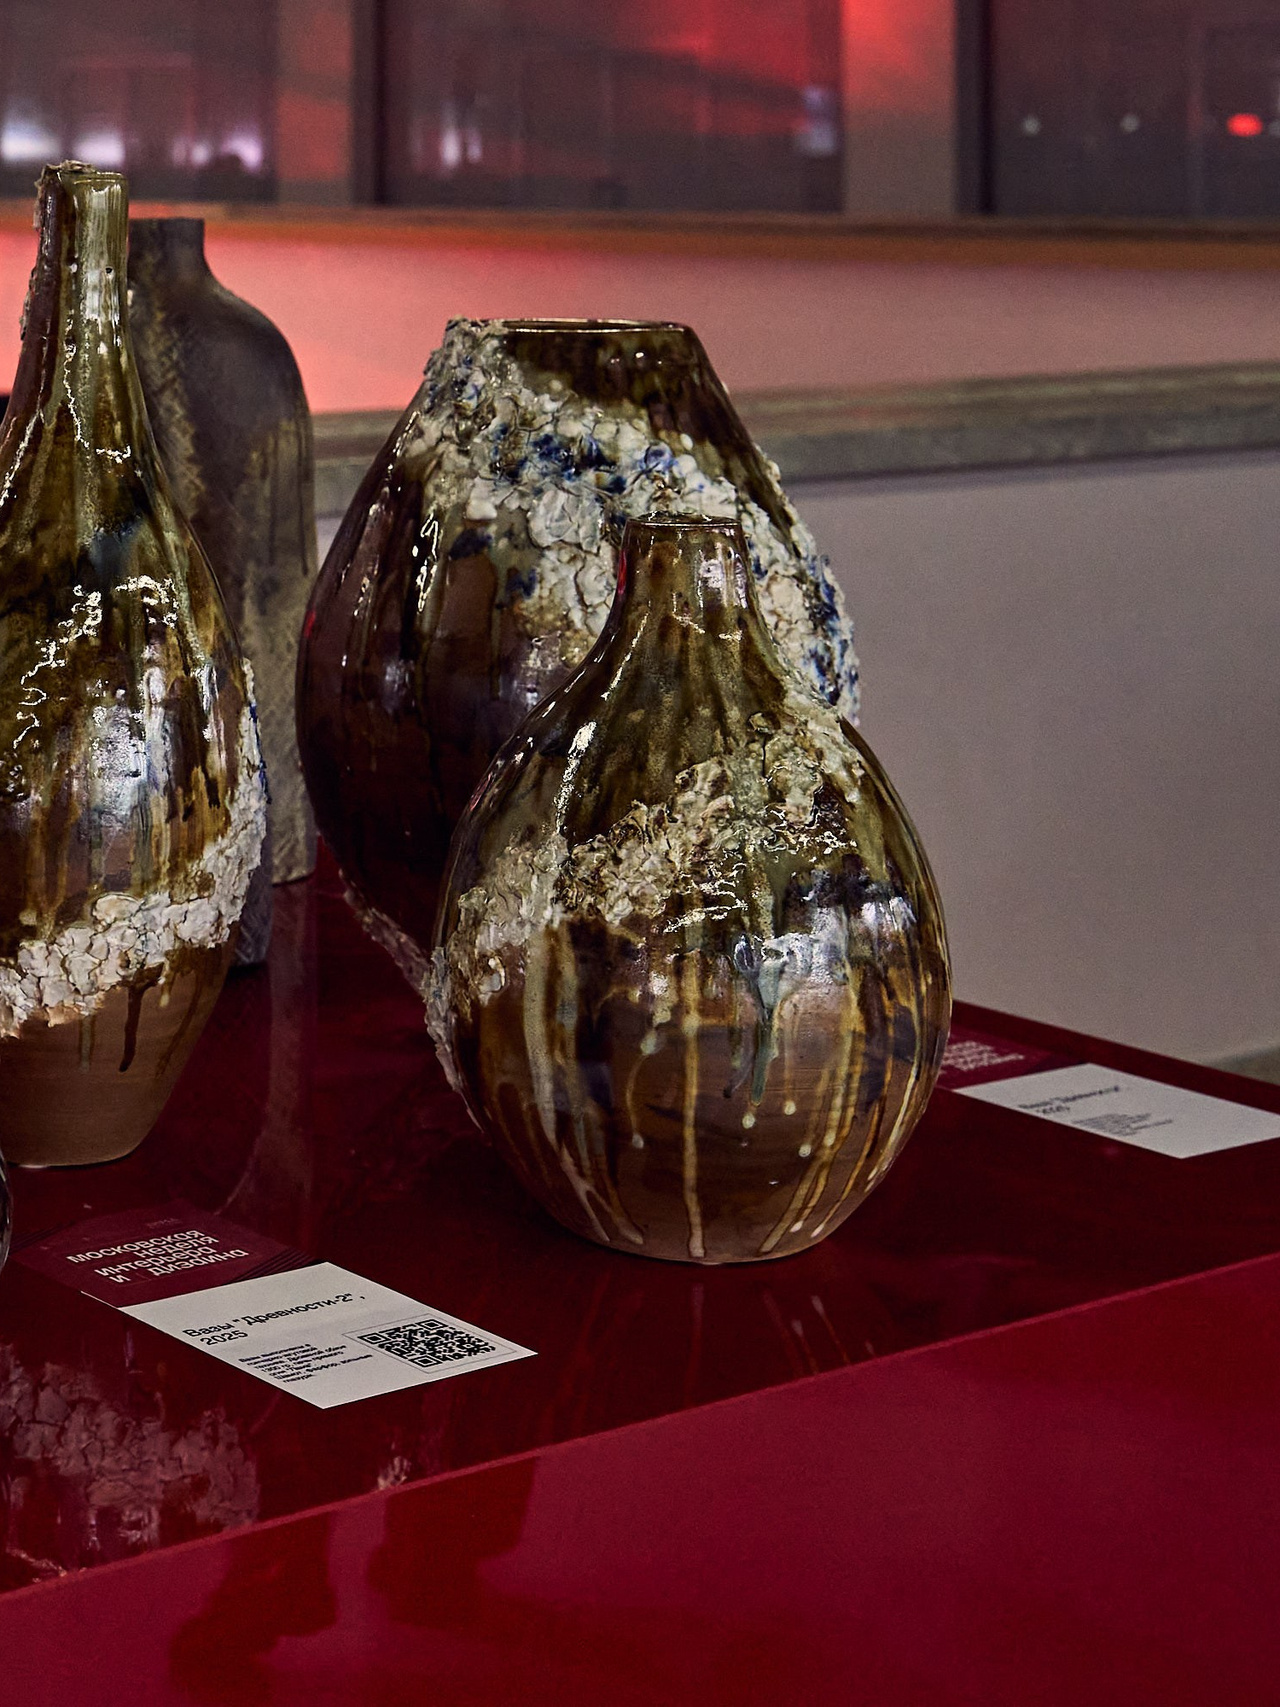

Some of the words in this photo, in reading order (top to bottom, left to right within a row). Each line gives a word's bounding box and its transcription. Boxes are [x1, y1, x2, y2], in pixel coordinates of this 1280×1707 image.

[66, 1230, 206, 1264] московская
[134, 1236, 220, 1258] неделя
[95, 1246, 217, 1277] интерьера
[109, 1275, 131, 1284] и
[182, 1323, 236, 1337] Вазы
[200, 1330, 249, 1346] 2025
